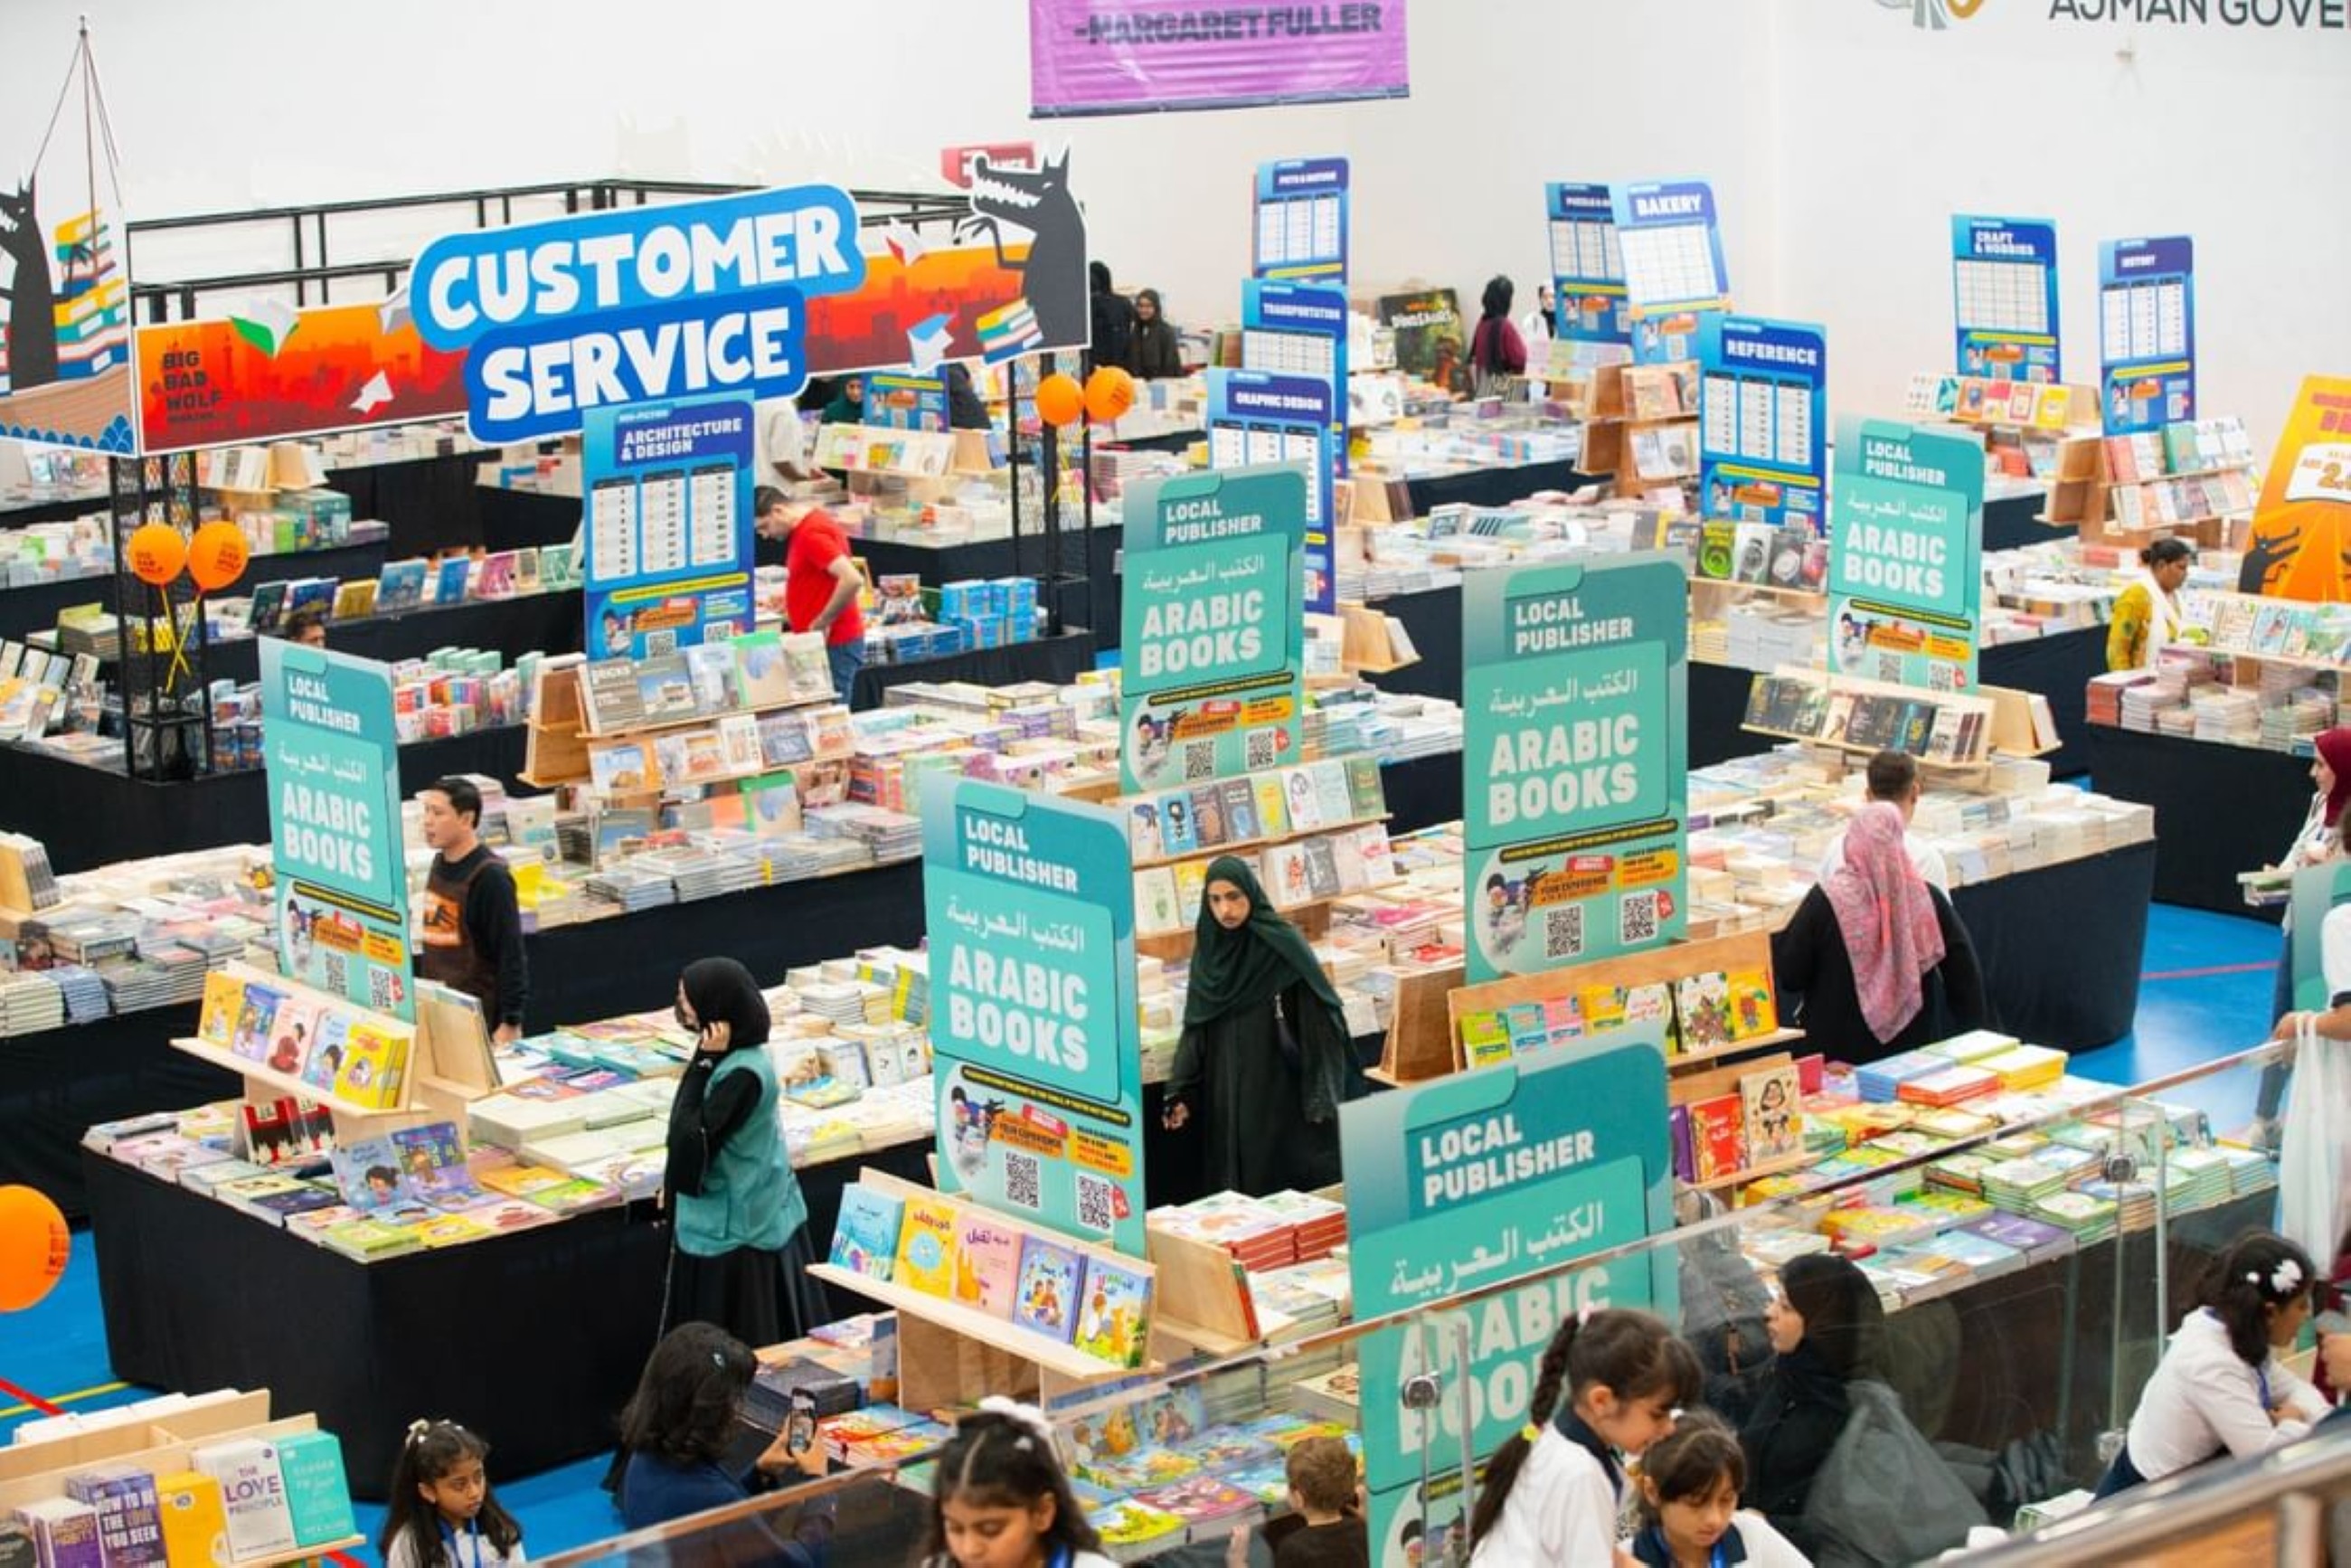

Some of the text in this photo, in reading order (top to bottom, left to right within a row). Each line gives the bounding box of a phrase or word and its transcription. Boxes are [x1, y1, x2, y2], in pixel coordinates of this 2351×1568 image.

[1268, 4, 1382, 36] FULLER
[2218, 0, 2351, 28] GOVE
[1636, 194, 1702, 217] BAKERY
[1975, 229, 2014, 244] CRAFT
[429, 205, 849, 331] CUSTOMER
[164, 351, 200, 369] BIG
[481, 307, 789, 421] SERVICE
[1726, 338, 1818, 366] REFERENCE
[164, 371, 207, 391] BAD
[165, 389, 222, 410] WOLF
[1235, 391, 1323, 411] GRAPHIC DESIGN
[624, 418, 741, 445] ARCHITECTURE
[621, 438, 693, 461] & DESIGN
[1865, 439, 1912, 462] LOCAL
[1865, 458, 1946, 486] PUBLISHER
[1166, 499, 1222, 522] LOCAL
[1165, 515, 1262, 544] PUBLISHER
[1846, 522, 1947, 565] ARABIC
[1845, 552, 1944, 598] BOOKS
[1141, 590, 1264, 640] ARABIC
[1515, 597, 1584, 627] LOCAL
[1139, 627, 1261, 677] BOOKS
[1515, 617, 1634, 655] PUBLISHER
[288, 675, 330, 703] LOCAL
[289, 699, 361, 734] PUBLISHER
[1488, 713, 1639, 778] ARABIC
[281, 782, 372, 839] ARABIC
[1488, 762, 1638, 827] BOOKS
[965, 815, 1030, 852] LOCAL
[284, 824, 373, 882] BOOKS
[967, 845, 1079, 893] PUBLISHER
[949, 944, 1089, 1020] ARABIC
[949, 992, 1089, 1072] BOOKS
[1421, 1113, 1523, 1168] LOCAL
[1424, 1129, 1595, 1208] PUBLISHER
[1526, 1201, 1604, 1257] الكتب
[1399, 1265, 1610, 1385] ARABIC
[124, 1492, 139, 1508] TO
[224, 1475, 281, 1503] LOVE
[101, 1514, 125, 1532] THE
[104, 1525, 158, 1549] YOU SEEK
